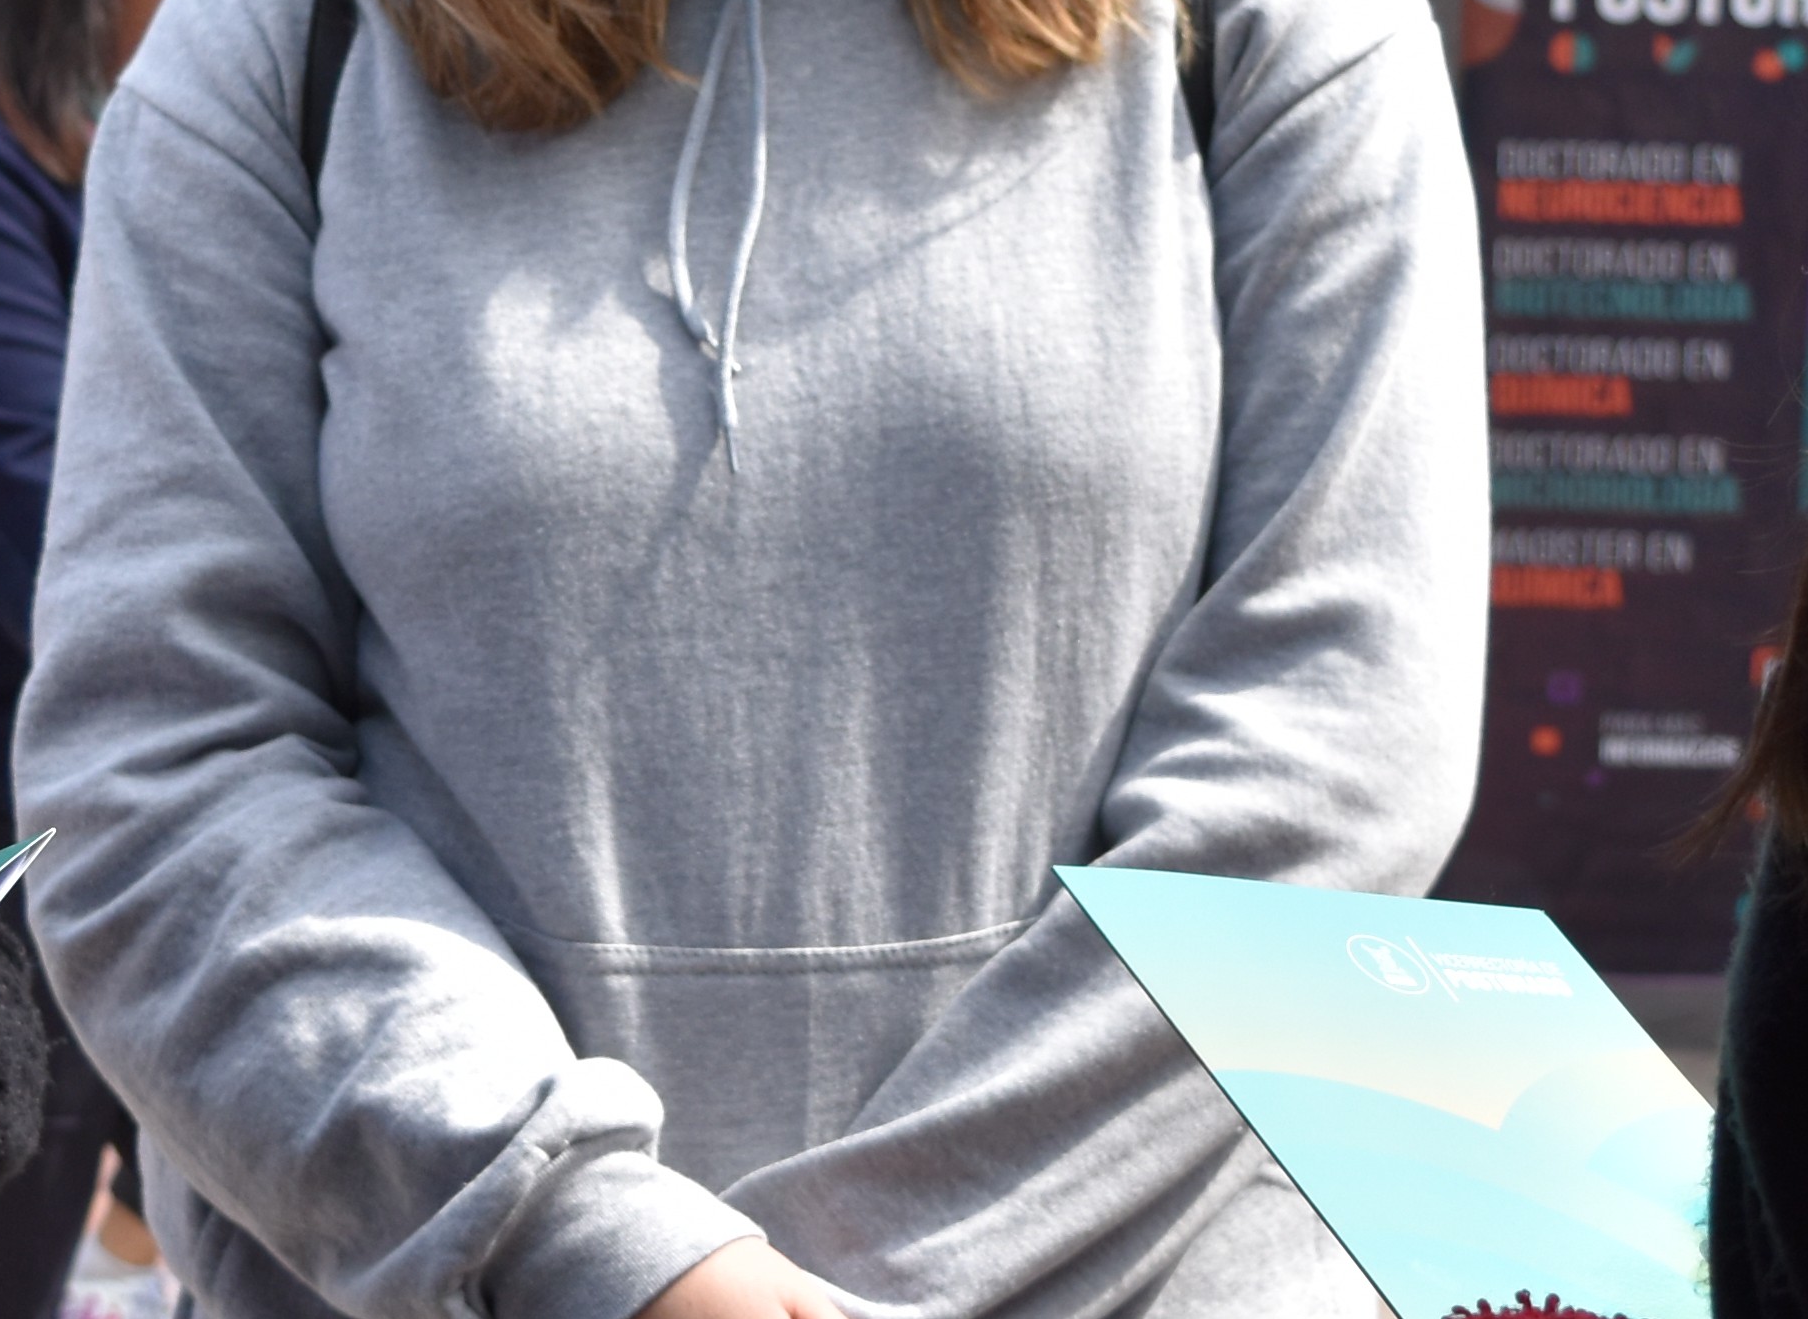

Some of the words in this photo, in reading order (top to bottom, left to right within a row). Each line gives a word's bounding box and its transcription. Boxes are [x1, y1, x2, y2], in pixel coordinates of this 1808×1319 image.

[1692, 142, 1740, 185] EN
[1688, 240, 1736, 283] EN
[1683, 337, 1732, 382] EN
[1678, 434, 1727, 478] EN
[1643, 532, 1694, 575] EN
